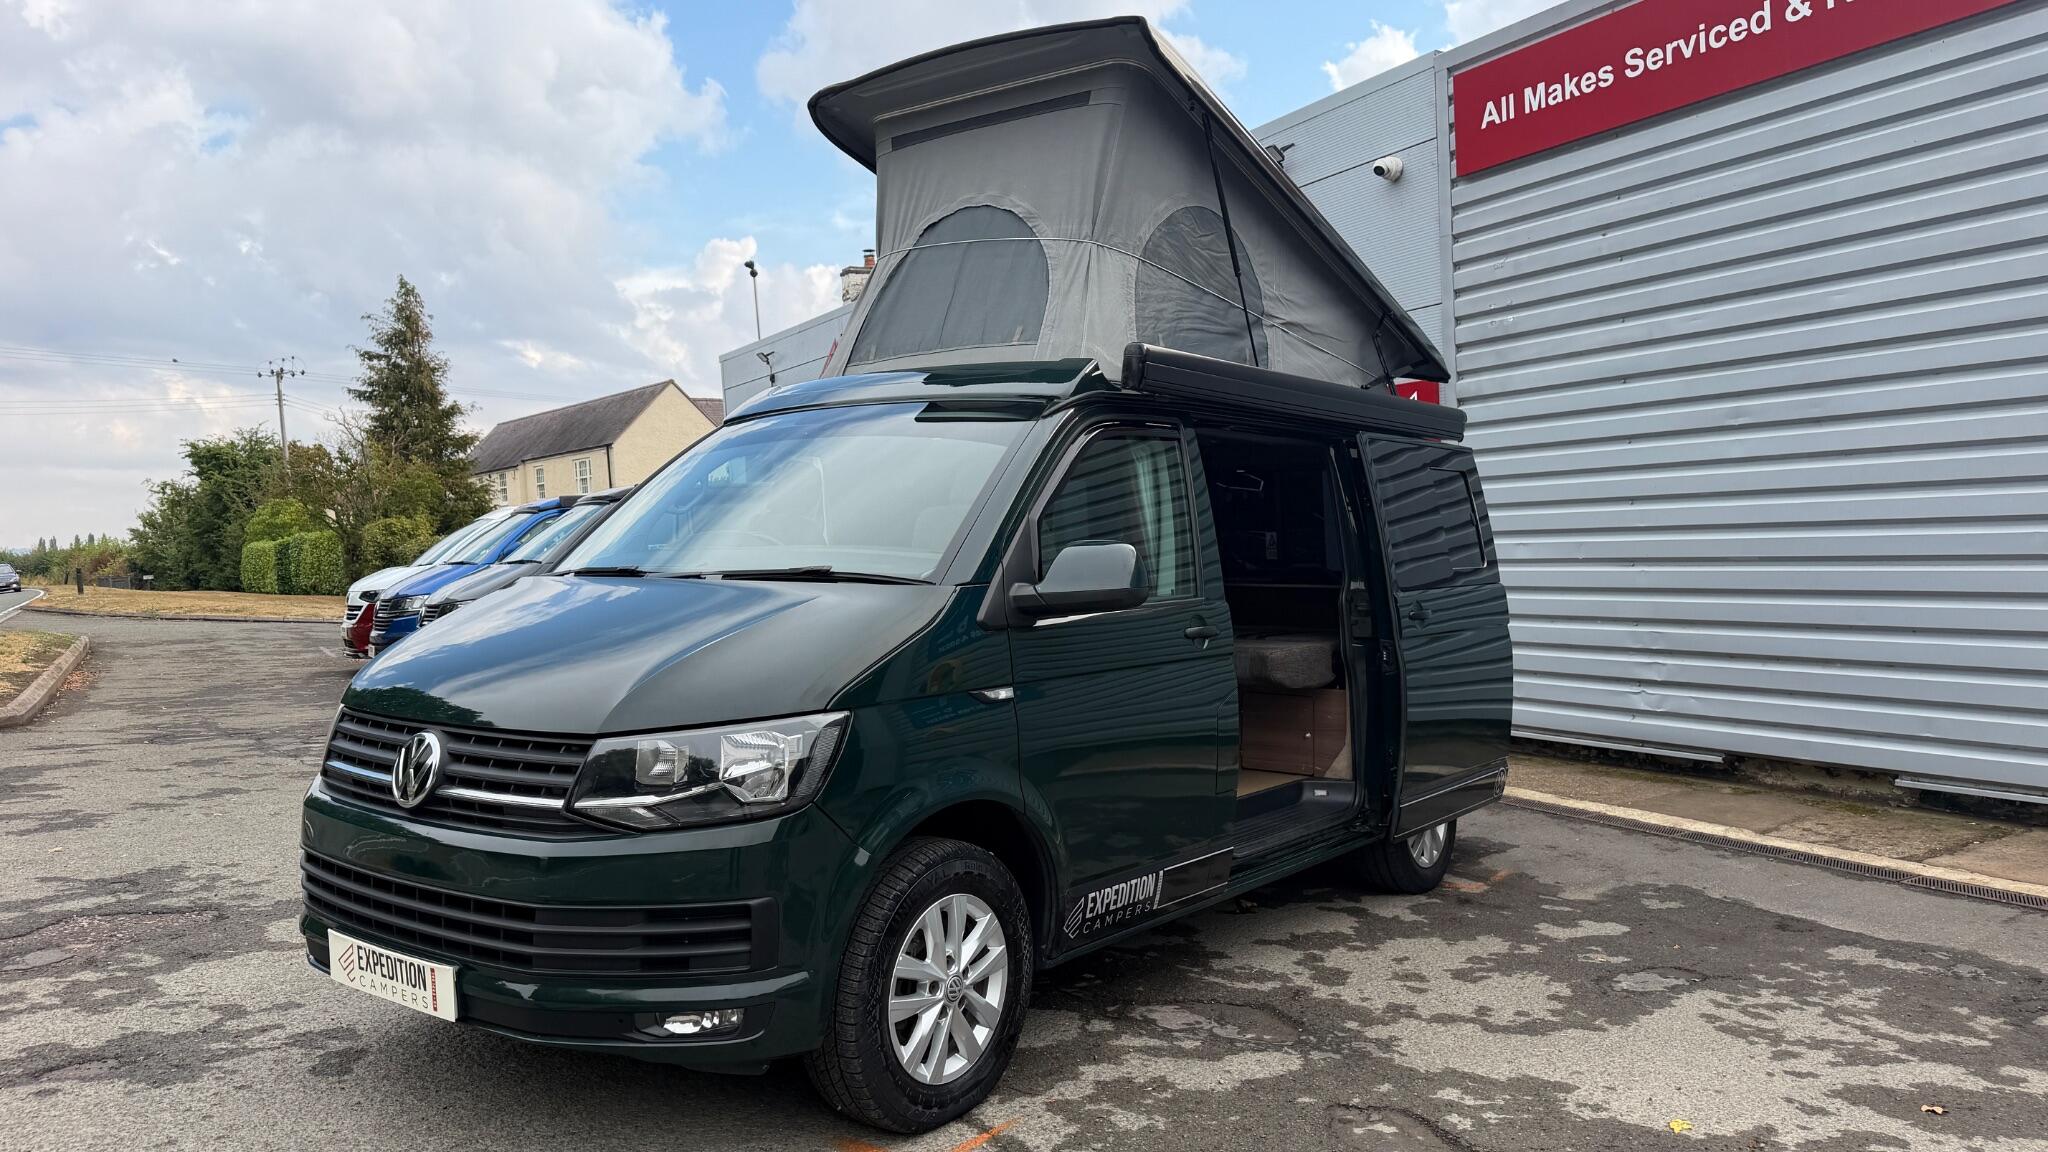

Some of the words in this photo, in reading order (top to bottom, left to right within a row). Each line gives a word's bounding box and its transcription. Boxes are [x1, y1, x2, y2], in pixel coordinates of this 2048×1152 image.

[1480, 92, 1515, 130] All
[1523, 65, 1615, 114] Makes
[1624, 0, 1772, 79] Serviced
[1082, 900, 1151, 934] CAMPERS
[1085, 872, 1156, 919] EXPEDITION
[356, 944, 428, 992] EXPEDITION
[359, 975, 429, 1009] CAMPERS
